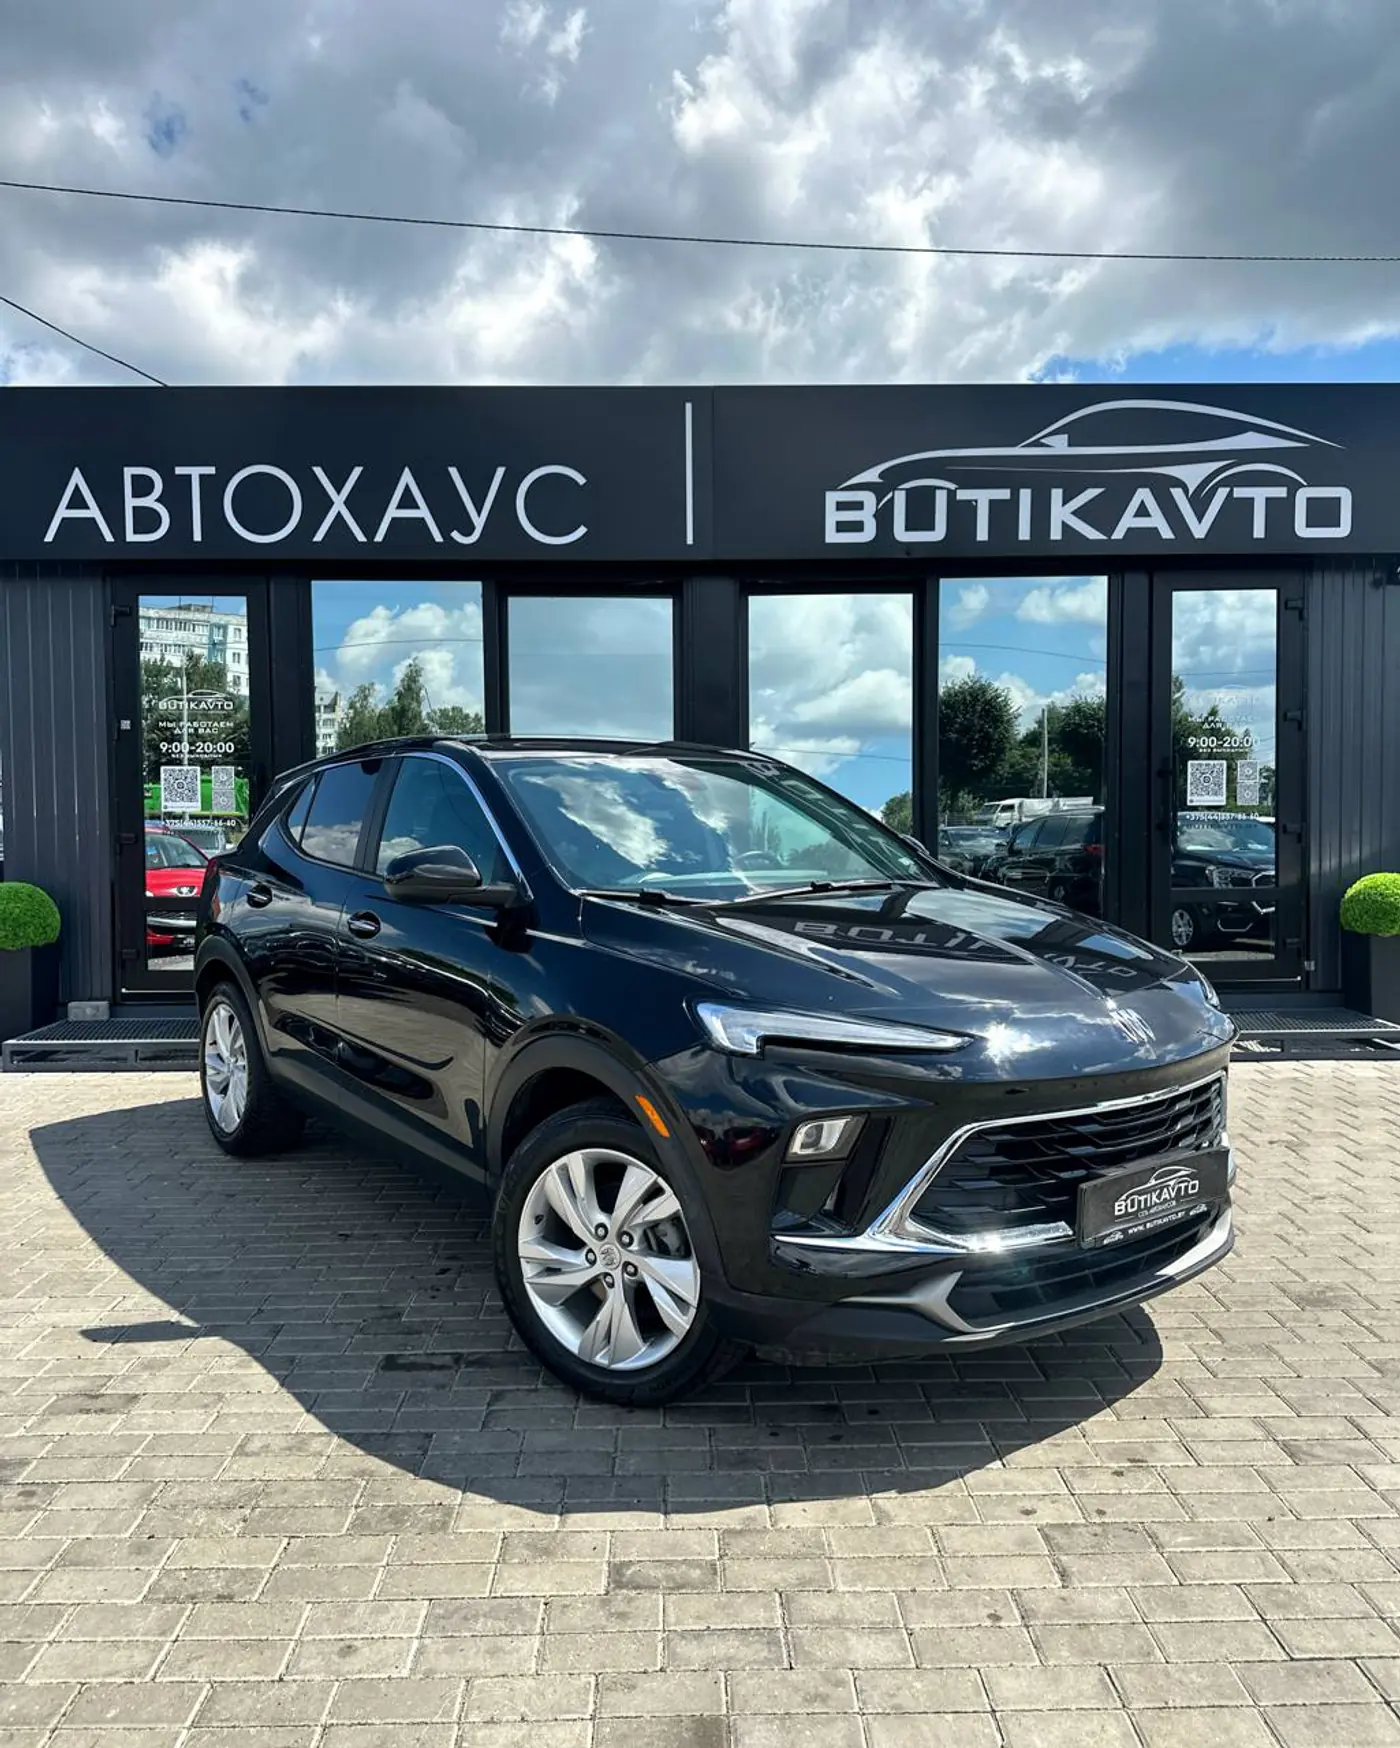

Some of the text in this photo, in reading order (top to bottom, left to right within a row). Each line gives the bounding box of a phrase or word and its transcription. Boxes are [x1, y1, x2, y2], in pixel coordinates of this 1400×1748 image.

[44, 464, 588, 544] АВТОХАУС
[825, 485, 1352, 543] BUTIKAVTO
[159, 742, 235, 753] 9:00-20:00
[1187, 736, 1261, 747] 9:00-20:00
[1114, 1179, 1200, 1216] BUTIKAVTO
